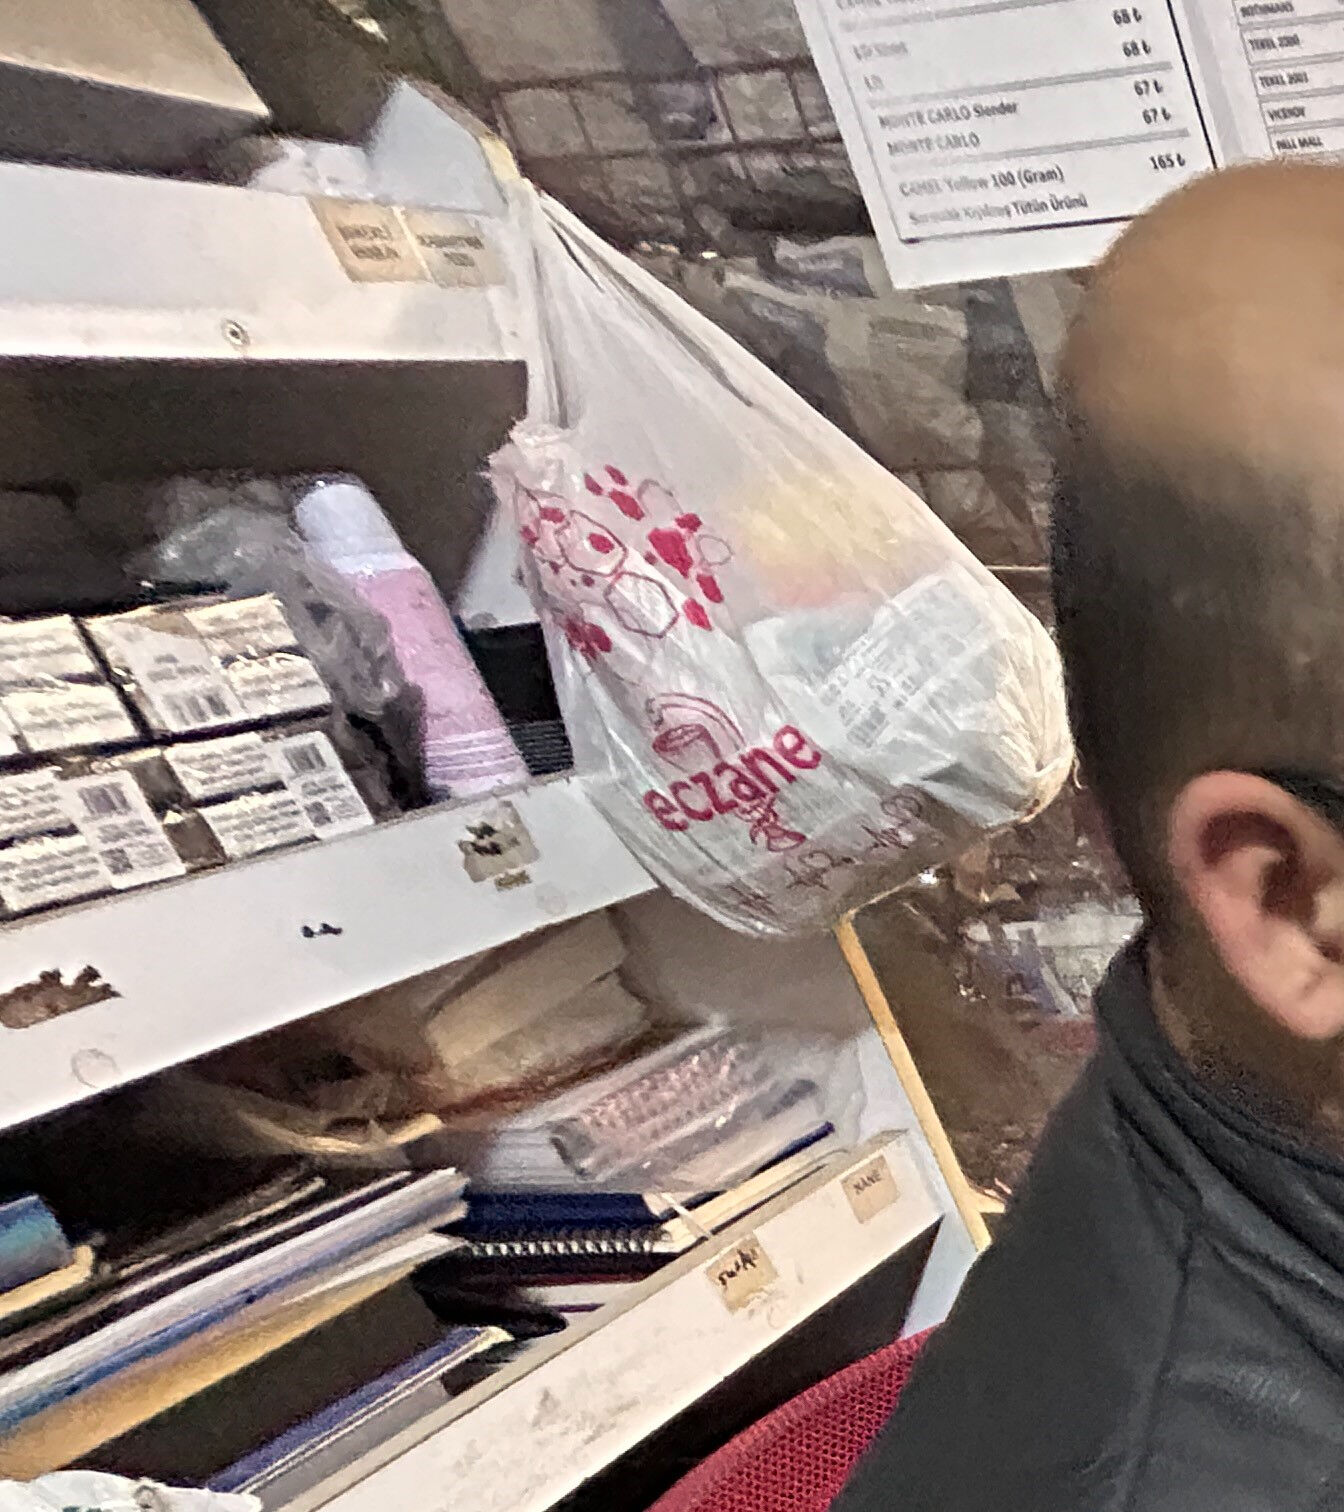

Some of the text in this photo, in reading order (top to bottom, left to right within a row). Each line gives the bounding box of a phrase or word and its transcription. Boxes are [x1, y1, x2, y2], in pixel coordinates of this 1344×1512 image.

[1113, 9, 1130, 25] 68
[1133, 80, 1150, 96] 67
[1142, 108, 1159, 125] 67
[1149, 153, 1174, 171] 165
[991, 171, 1016, 187] 100
[1017, 165, 1065, 188] (Gram)
[643, 725, 822, 832] eczane
